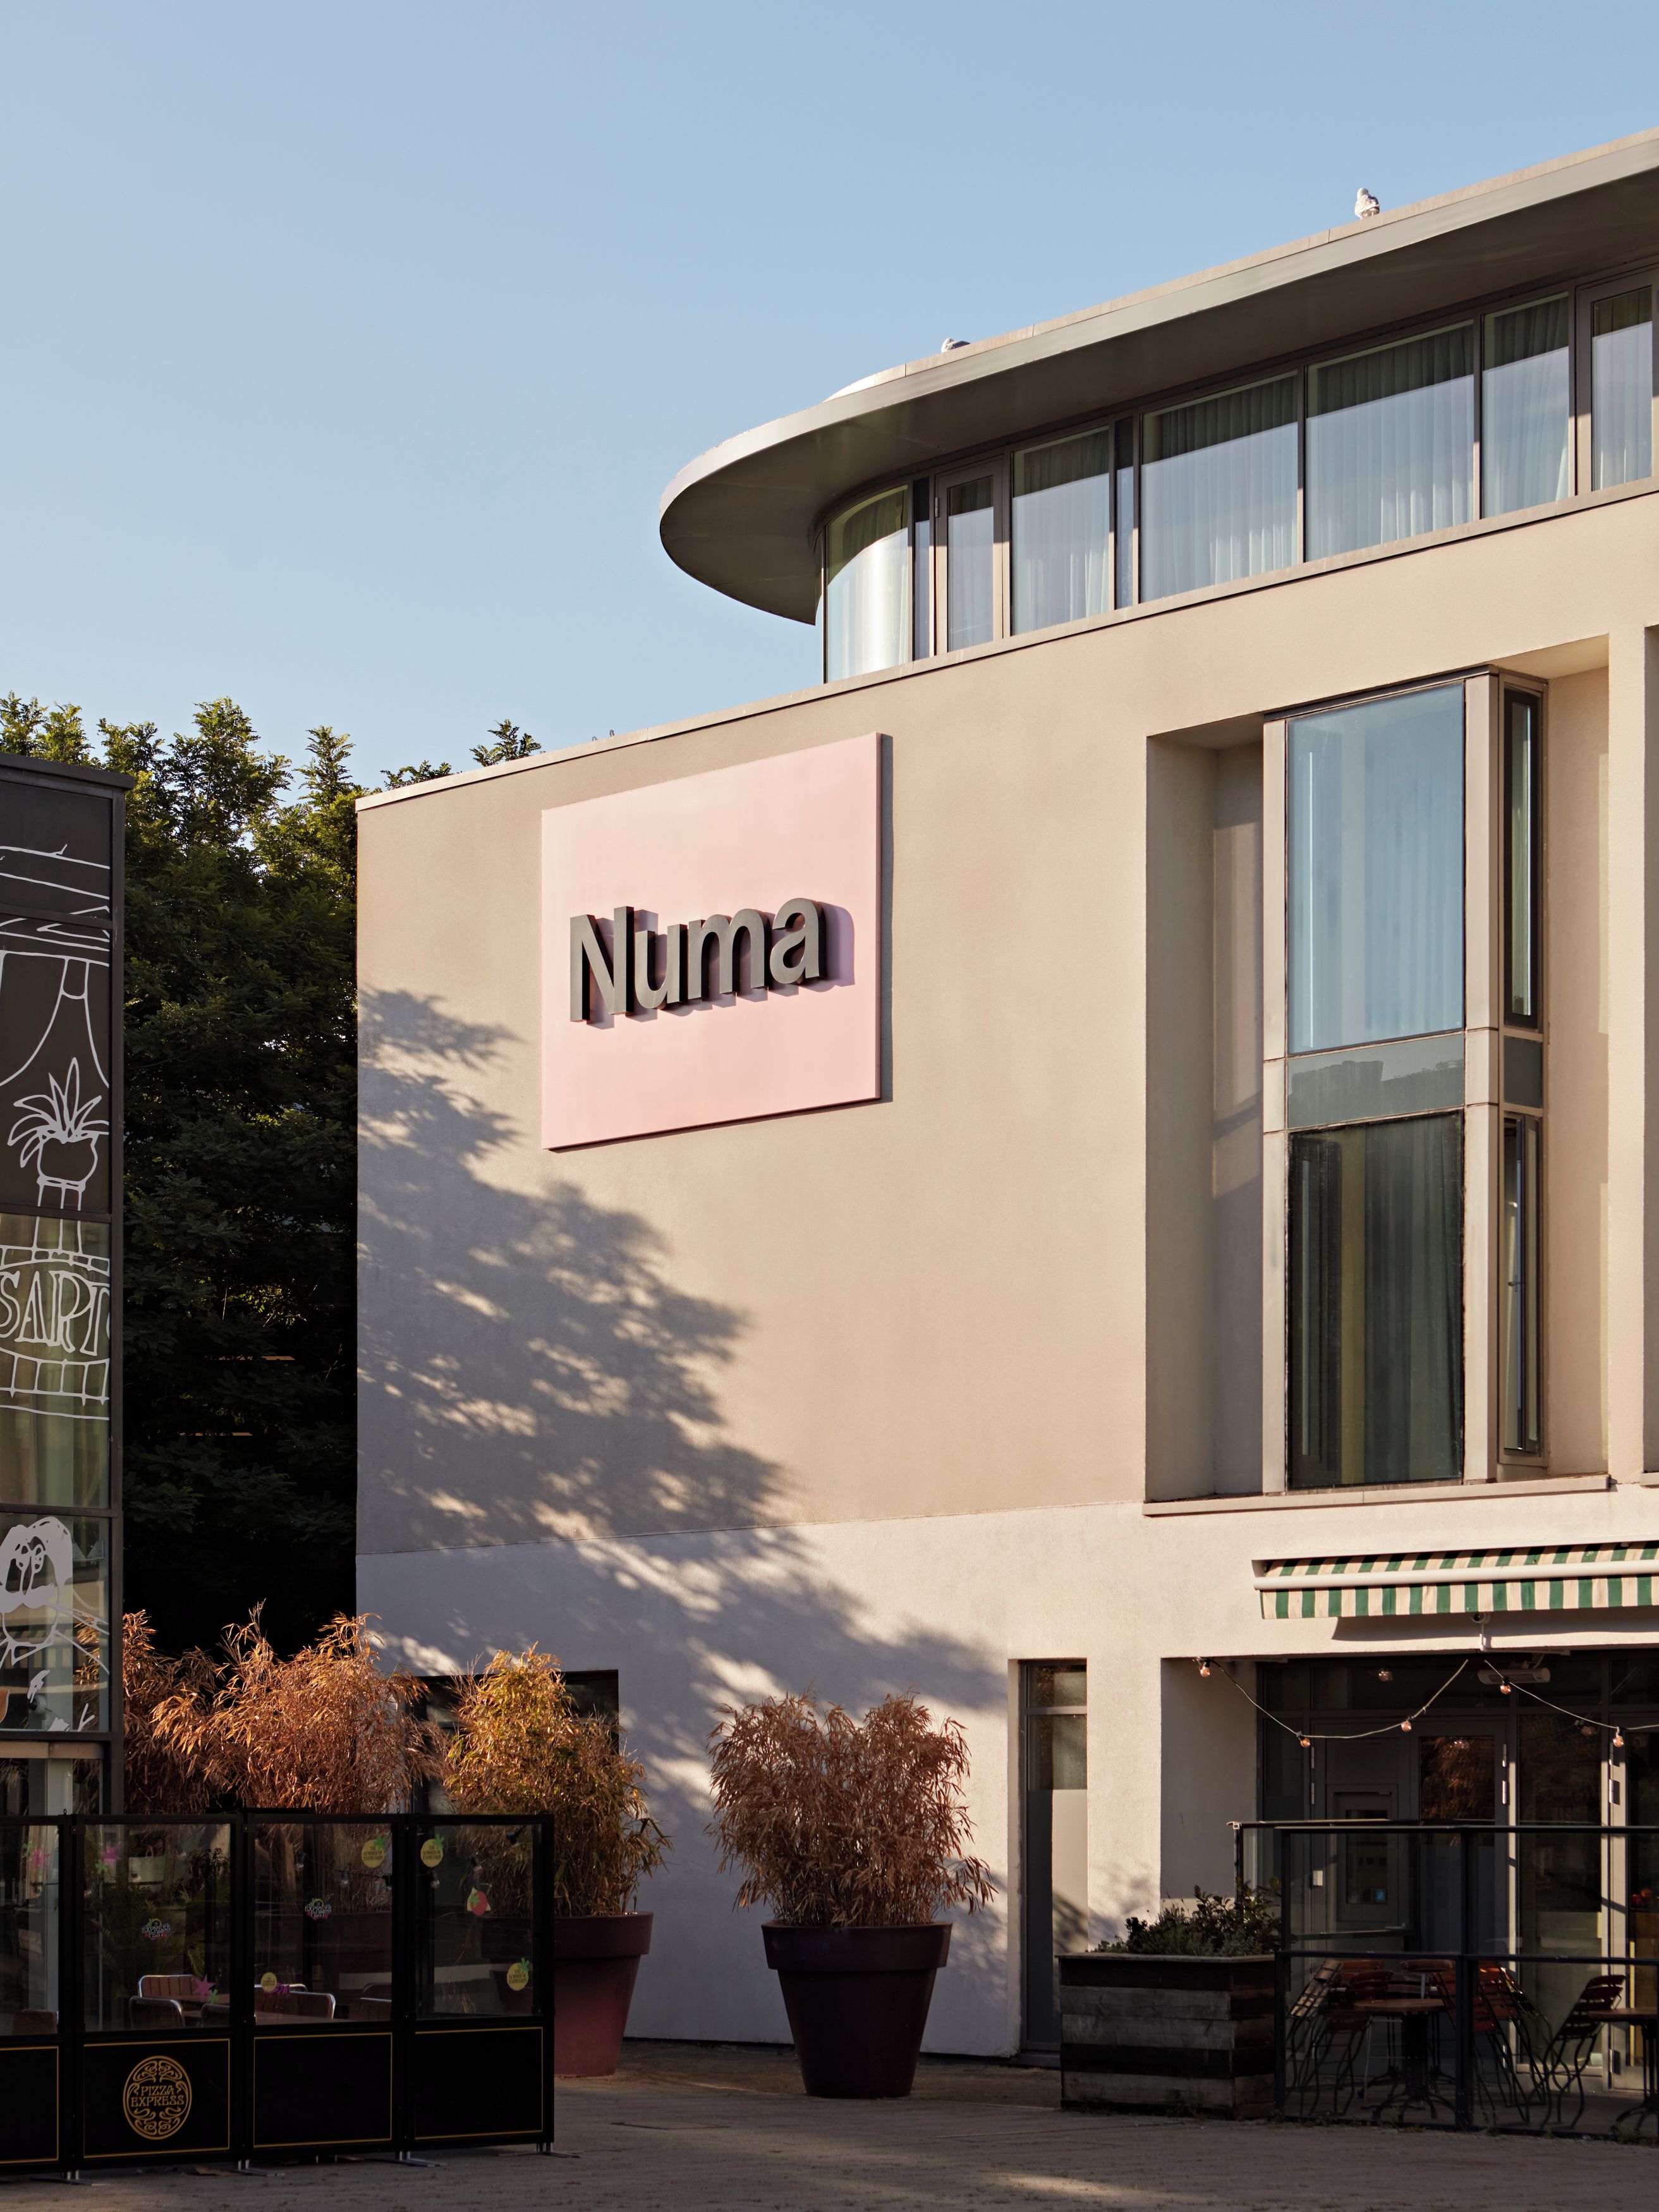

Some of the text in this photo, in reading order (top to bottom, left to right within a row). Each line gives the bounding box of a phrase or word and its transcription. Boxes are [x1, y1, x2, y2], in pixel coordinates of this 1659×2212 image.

[570, 897, 825, 1023] Numa
[142, 1924, 171, 1933] EXPRESS
[140, 2084, 175, 2096] PIZZA
[130, 2094, 185, 2108] EXPRESS
